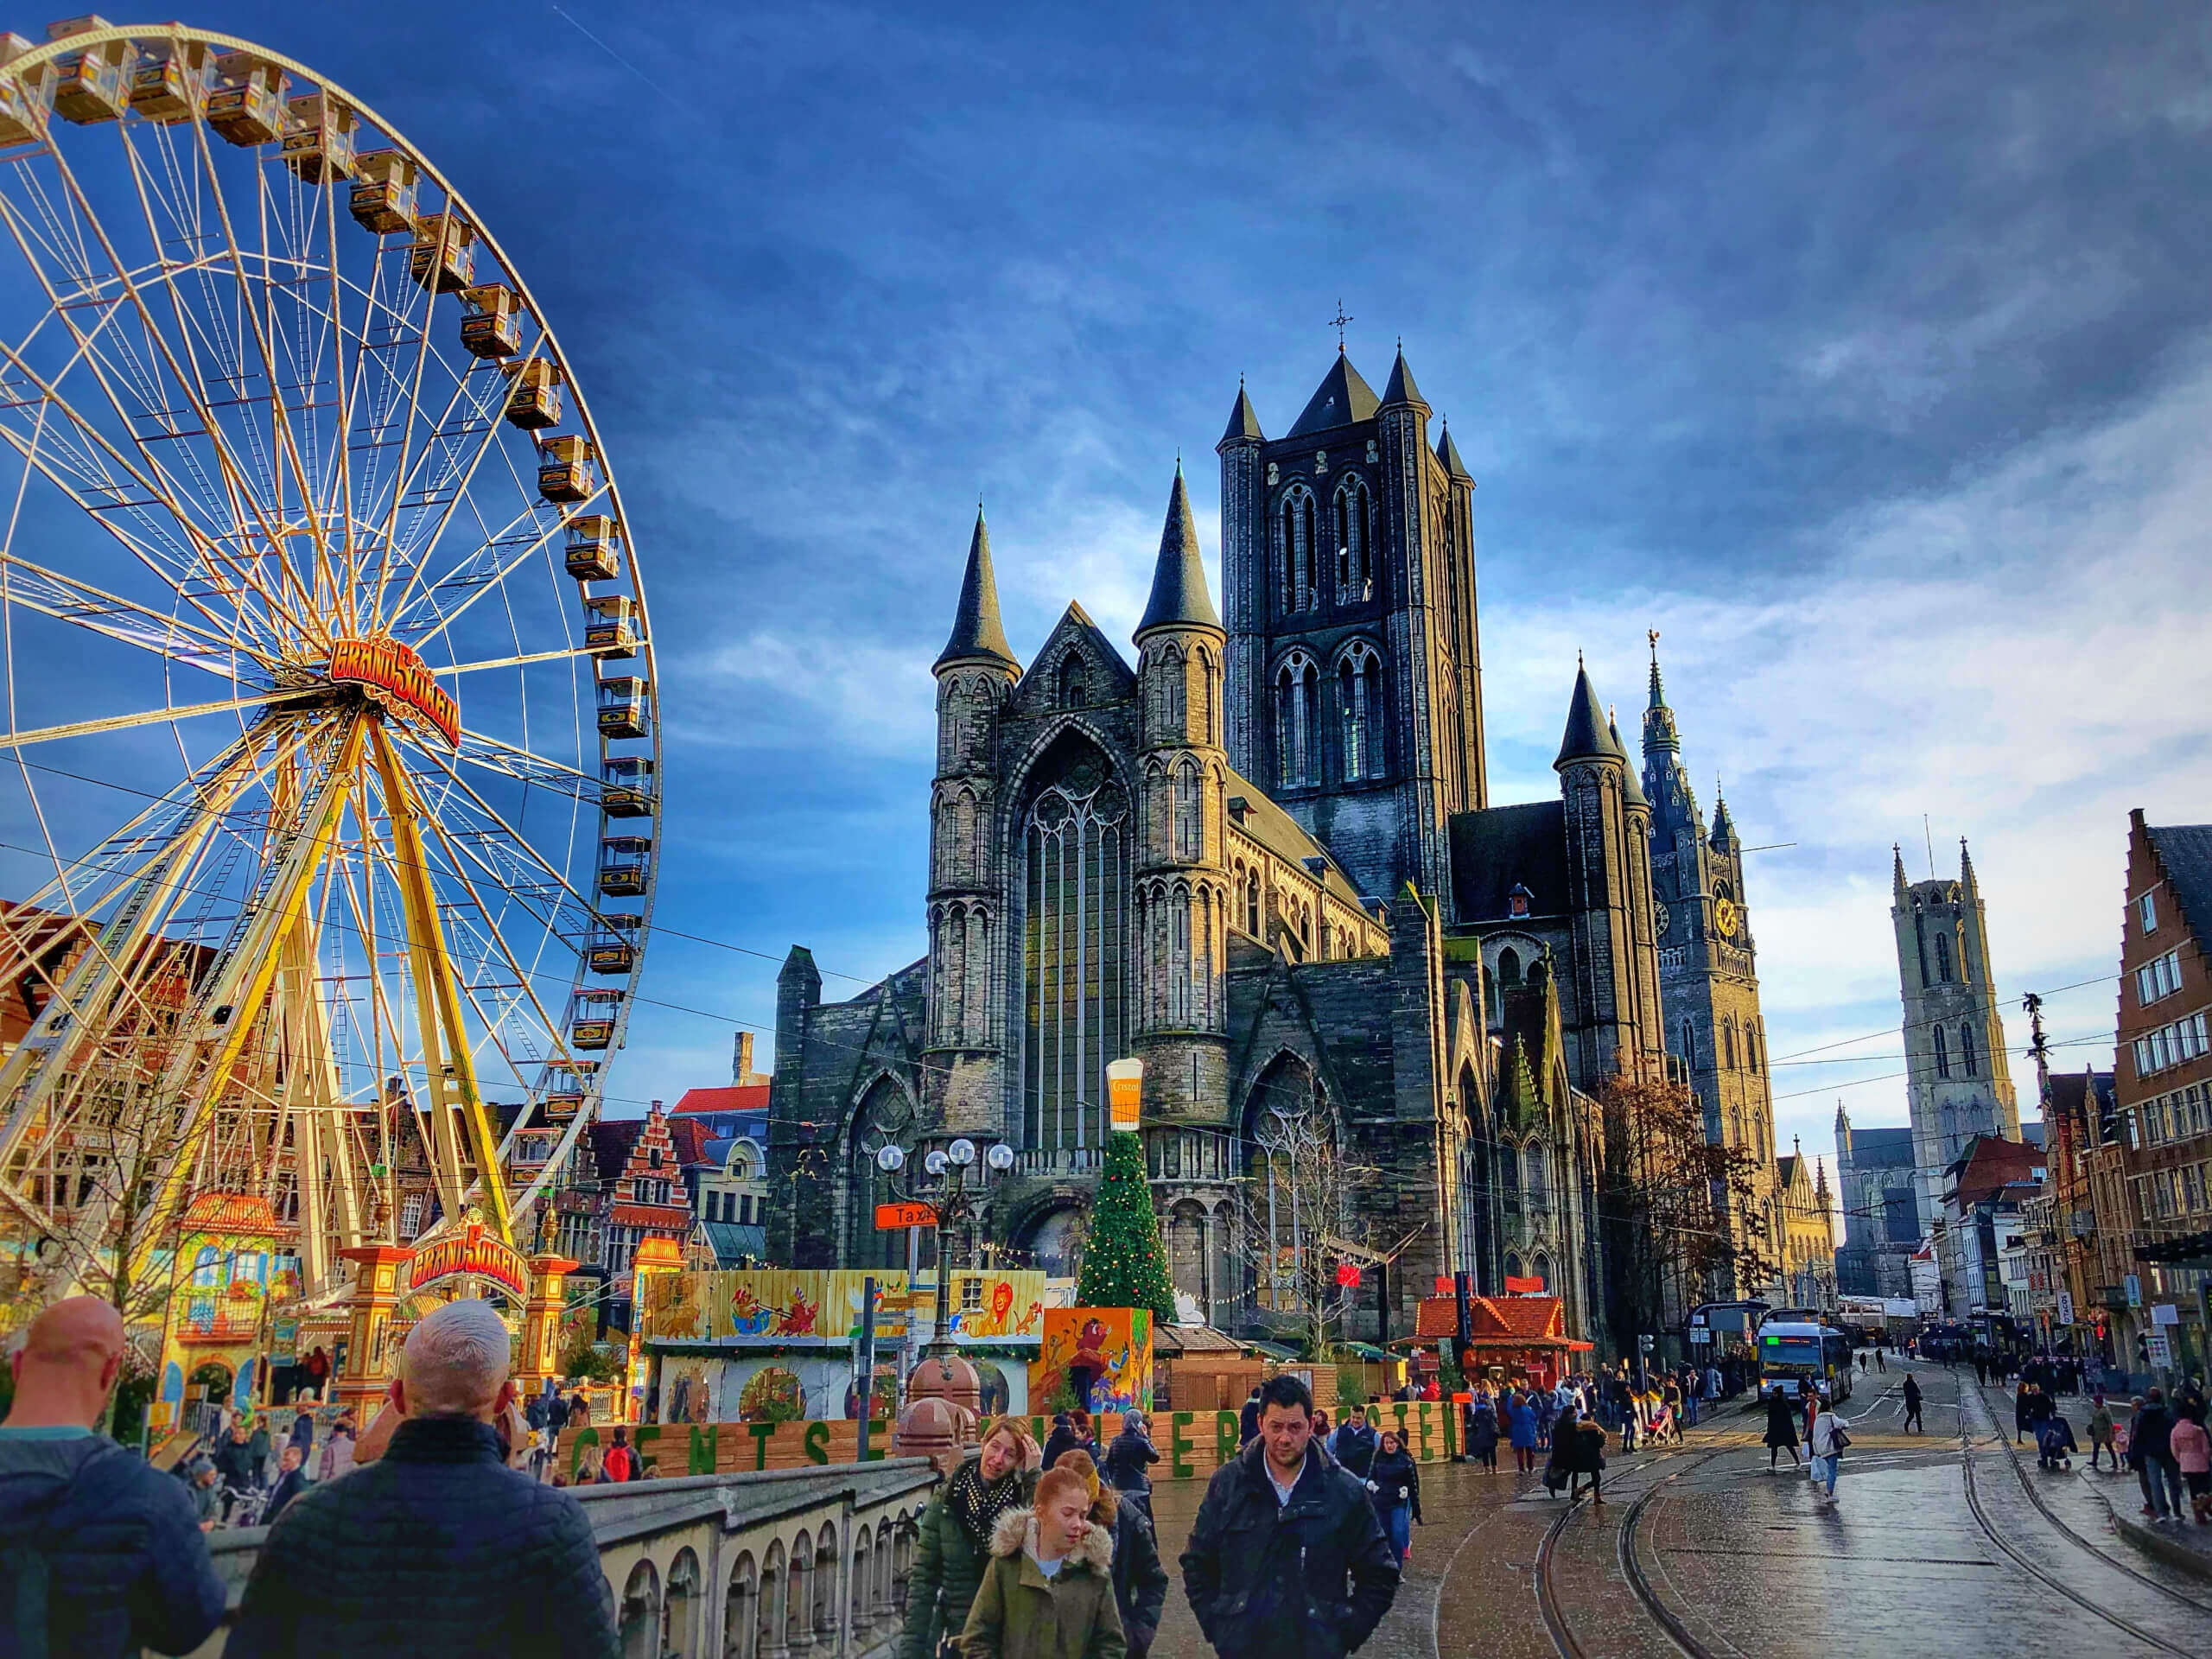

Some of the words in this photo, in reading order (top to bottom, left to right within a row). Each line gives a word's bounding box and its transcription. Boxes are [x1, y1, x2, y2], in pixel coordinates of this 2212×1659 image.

[334, 640, 395, 689] GRAND
[1112, 1080, 1139, 1092] Cristal
[896, 1208, 931, 1223] Taxi
[410, 1236, 467, 1289] GRAND
[465, 1224, 524, 1294] SOLEIL
